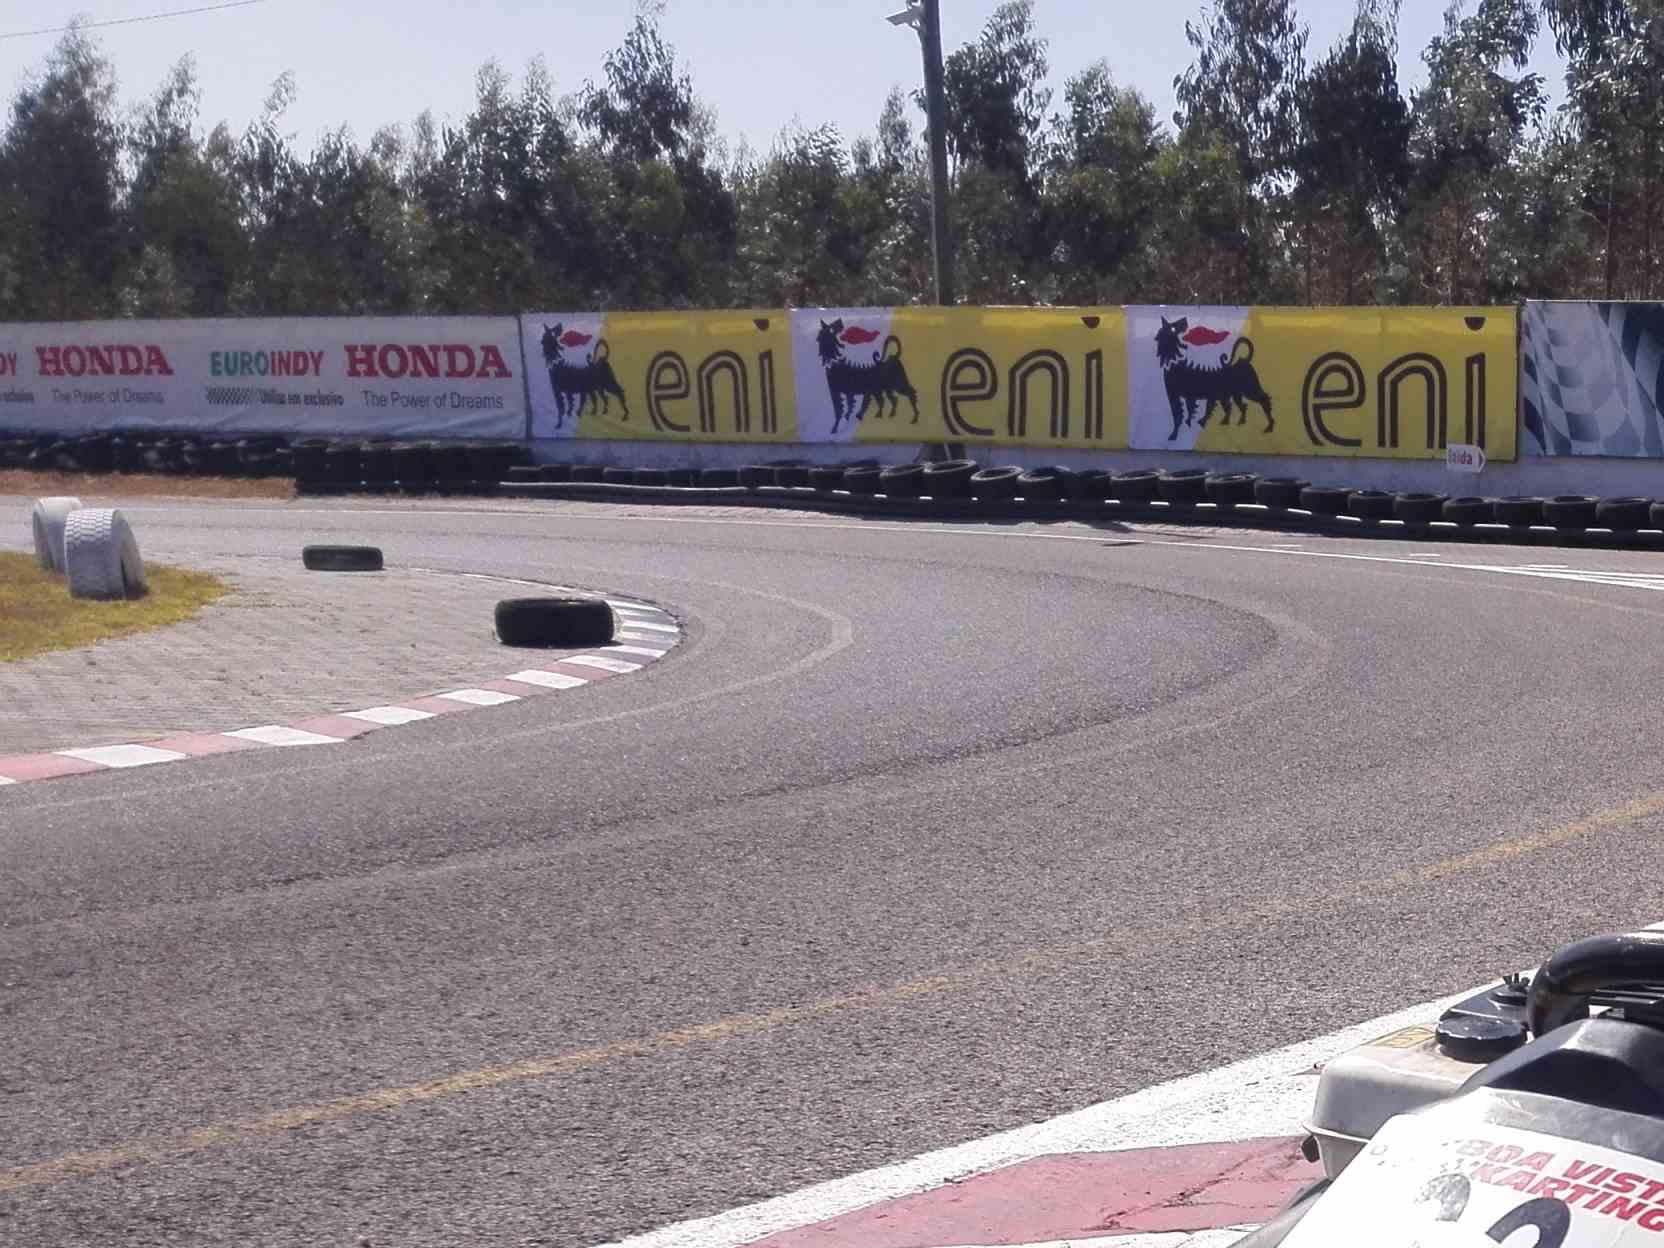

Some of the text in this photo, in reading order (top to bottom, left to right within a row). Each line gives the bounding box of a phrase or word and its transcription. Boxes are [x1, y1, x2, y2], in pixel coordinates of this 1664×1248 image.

[35, 345, 174, 376] HONDA
[210, 351, 324, 377] EUROINDY
[344, 344, 512, 378] HONDA
[646, 319, 777, 433] eni
[941, 316, 1103, 438] eni
[1302, 316, 1486, 449] eni
[361, 390, 504, 409] The Power of Dreams
[1456, 1139, 1554, 1171] BOA
